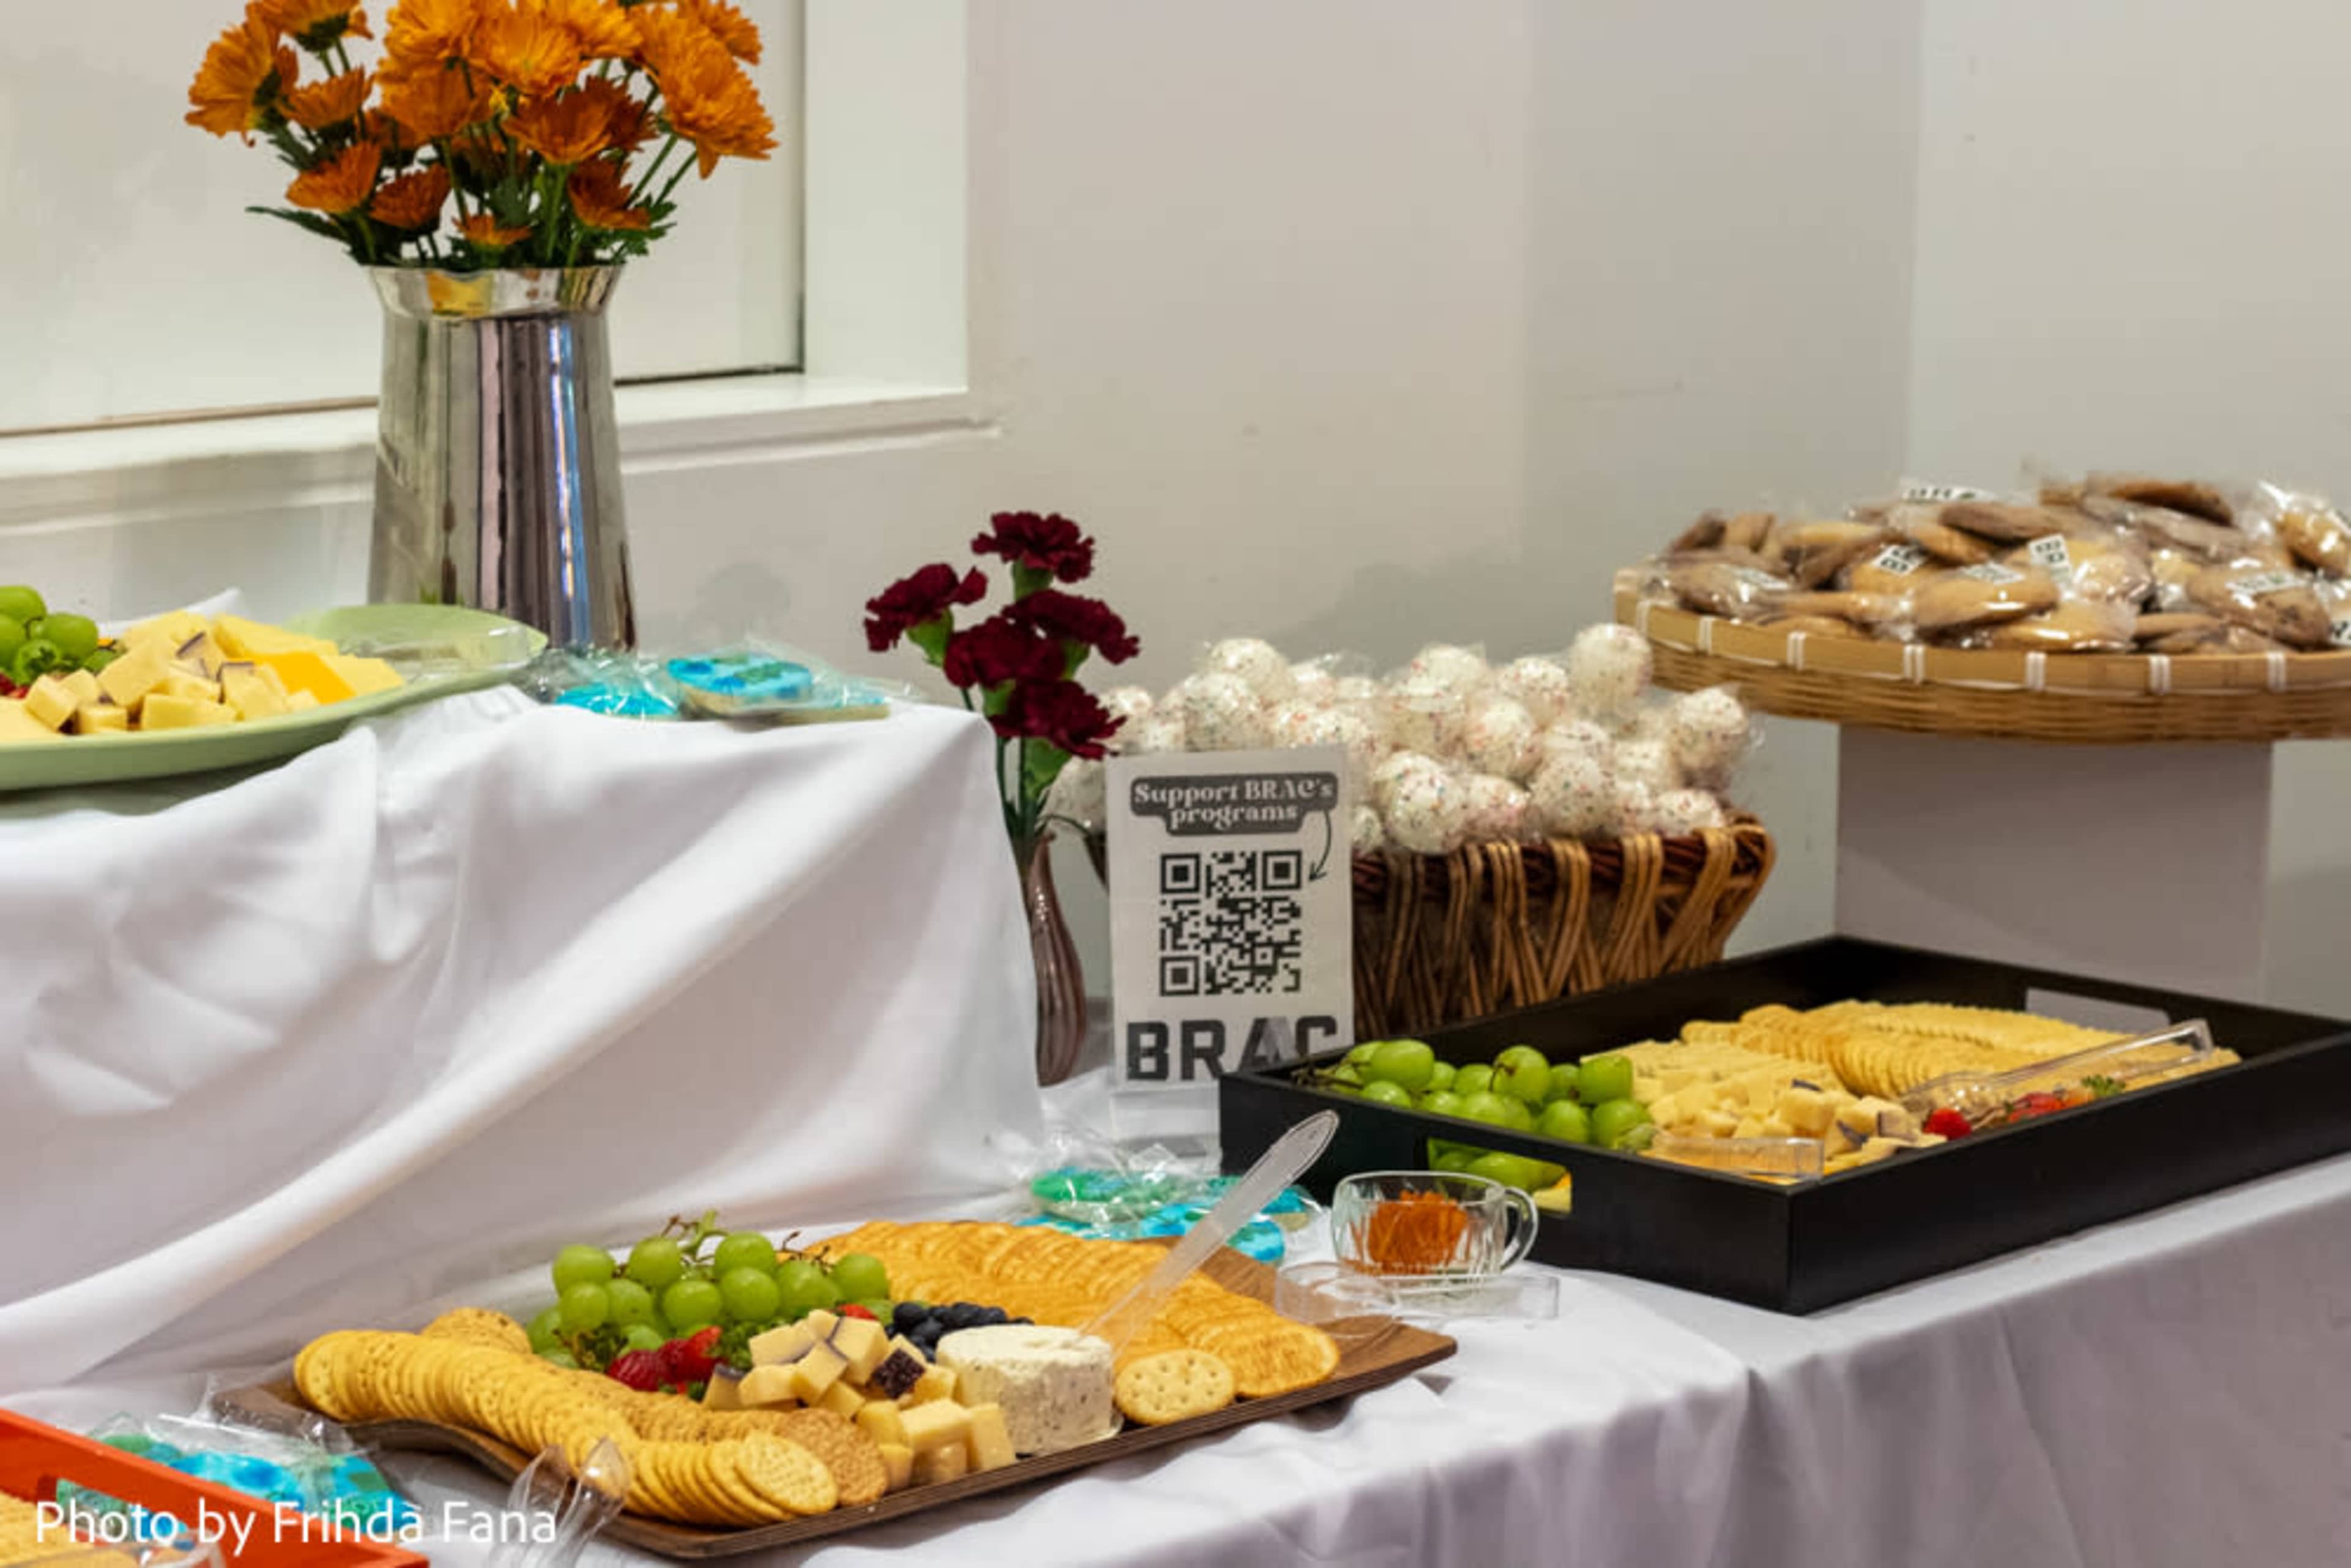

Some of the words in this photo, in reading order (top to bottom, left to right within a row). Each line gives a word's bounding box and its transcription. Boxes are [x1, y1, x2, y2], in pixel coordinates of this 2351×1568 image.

[1134, 782, 1238, 808] Support
[1244, 778, 1335, 800] BRAC's
[1170, 804, 1299, 831] programs
